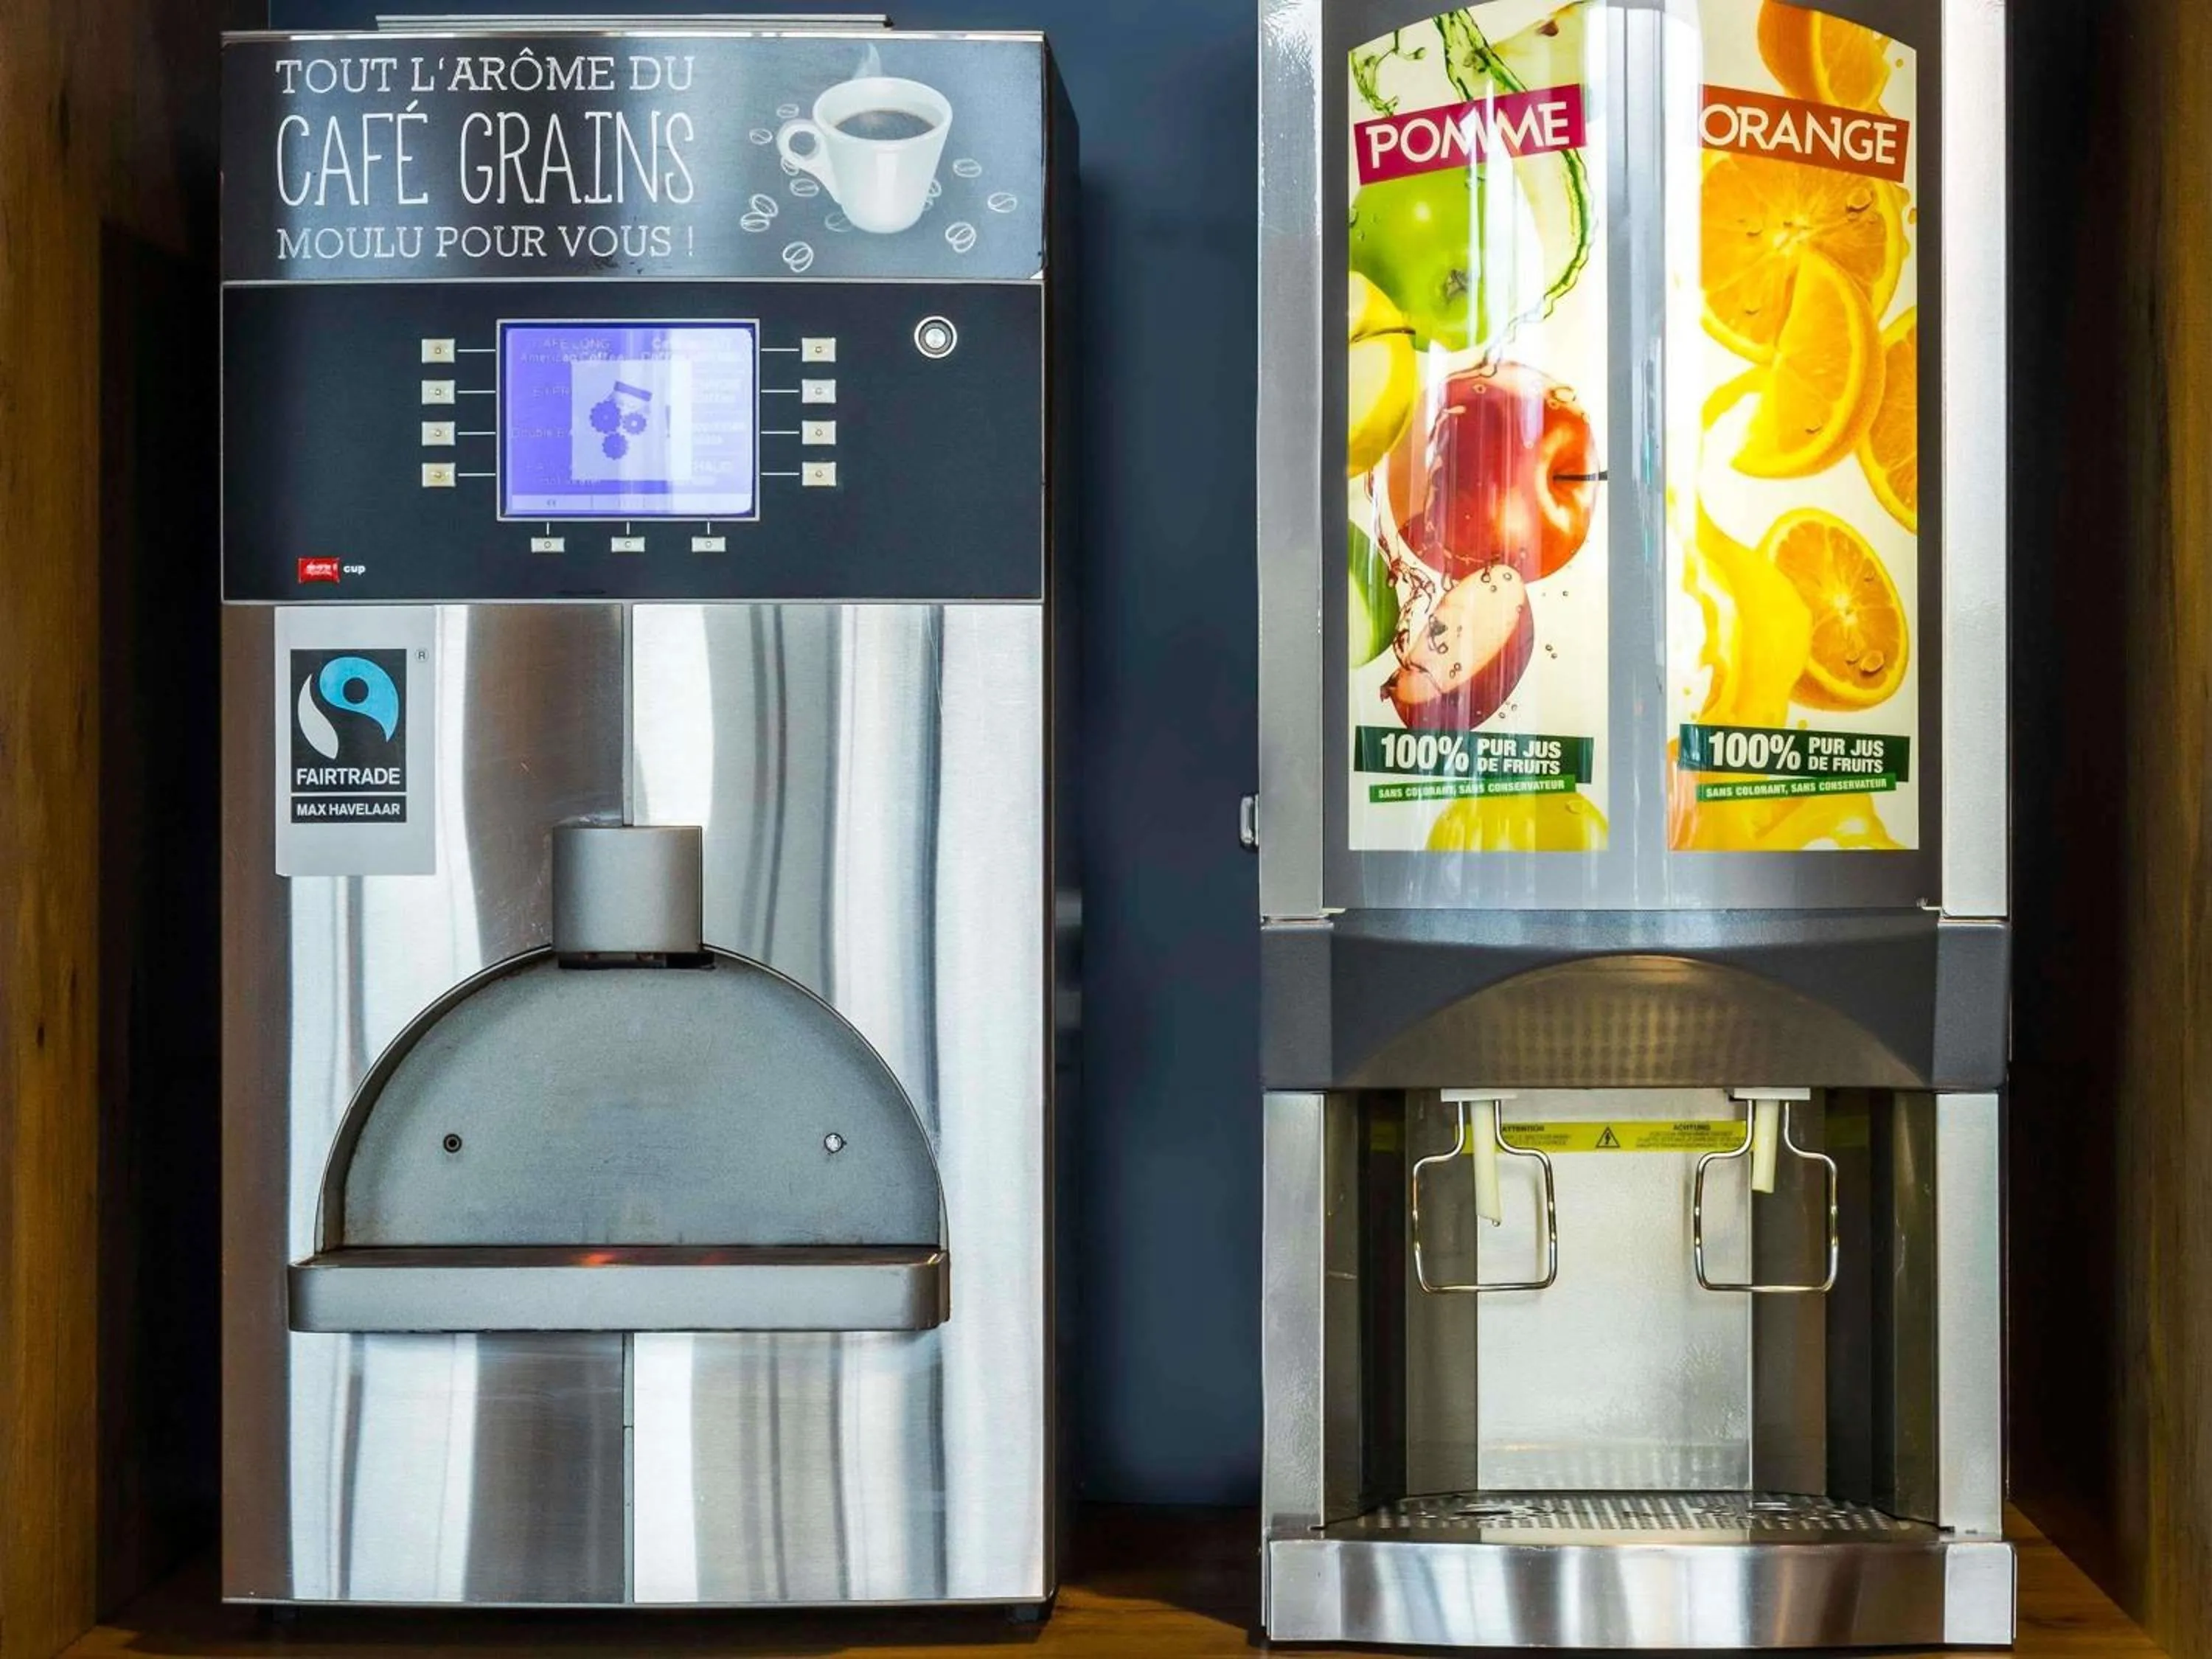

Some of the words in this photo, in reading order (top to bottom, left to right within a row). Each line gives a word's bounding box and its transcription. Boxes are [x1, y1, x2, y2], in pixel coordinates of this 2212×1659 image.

[276, 58, 397, 94] TOUT
[411, 47, 614, 92] L'ARÔME
[629, 56, 695, 90] DU
[1365, 101, 1570, 169] POMME
[1698, 103, 1897, 164] ORANGE
[276, 100, 428, 206] CAFÉ
[459, 109, 695, 204] GRAINS
[276, 227, 421, 260] MOULU
[436, 226, 547, 257] POUR
[558, 226, 671, 257] VOUS
[343, 565, 366, 575] cup
[1381, 733, 1470, 772] 100%
[1477, 738, 1517, 757] PUR
[1523, 740, 1561, 759] JUS
[1708, 731, 1801, 771] 100%
[1809, 737, 1845, 756] PUR
[1850, 740, 1884, 757] JUS
[296, 768, 400, 785] FAIRTRADE
[1477, 757, 1498, 772] DE
[1503, 758, 1561, 775] FRUITS
[1808, 757, 1828, 771] DE
[1832, 758, 1884, 774] FRUITS
[1379, 788, 1402, 799] SANS
[1487, 779, 1565, 793] CONSERVATEUR
[1705, 787, 1733, 799] SANS
[1735, 784, 1789, 797] COLORANT,
[1791, 782, 1816, 793] SANS
[1818, 778, 1888, 792] CONSERVATEUR
[296, 803, 327, 816] MAX
[329, 802, 400, 815] HAVELAAR
